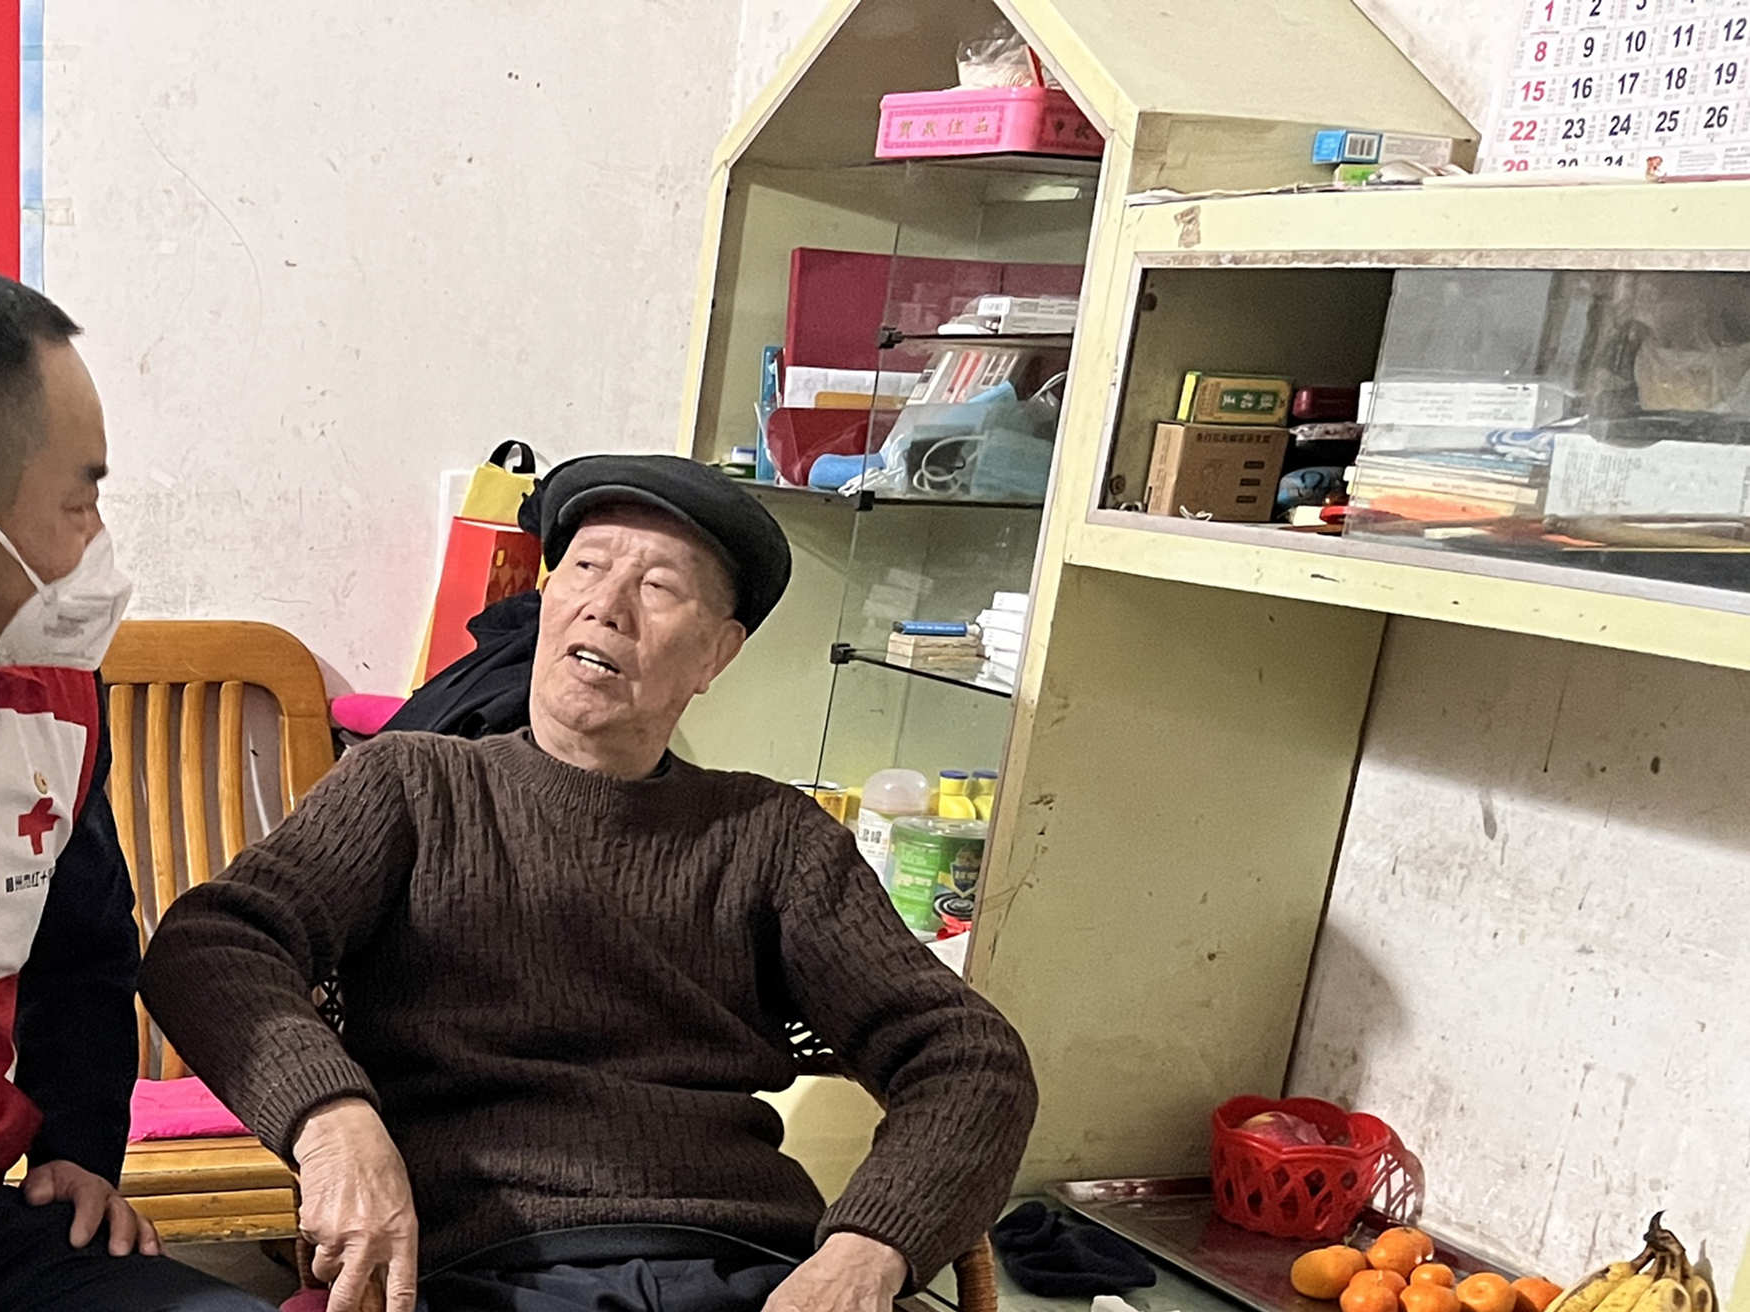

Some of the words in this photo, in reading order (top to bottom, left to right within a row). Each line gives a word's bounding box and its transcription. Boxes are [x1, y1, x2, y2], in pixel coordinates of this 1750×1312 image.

[1534, 41, 1548, 62] 8
[1583, 36, 1595, 58] 9
[1625, 30, 1647, 53] 10
[1673, 24, 1694, 48] 11
[1723, 17, 1748, 42] 12
[1521, 81, 1546, 102] 15
[1571, 77, 1594, 100] 16
[1618, 72, 1640, 95] 17
[1665, 67, 1688, 90] 18
[1714, 62, 1738, 86] 19
[1509, 120, 1538, 141] 22
[1561, 118, 1587, 140] 23
[1608, 113, 1632, 137] 24
[1654, 110, 1680, 133] 25
[1703, 105, 1729, 129] 26
